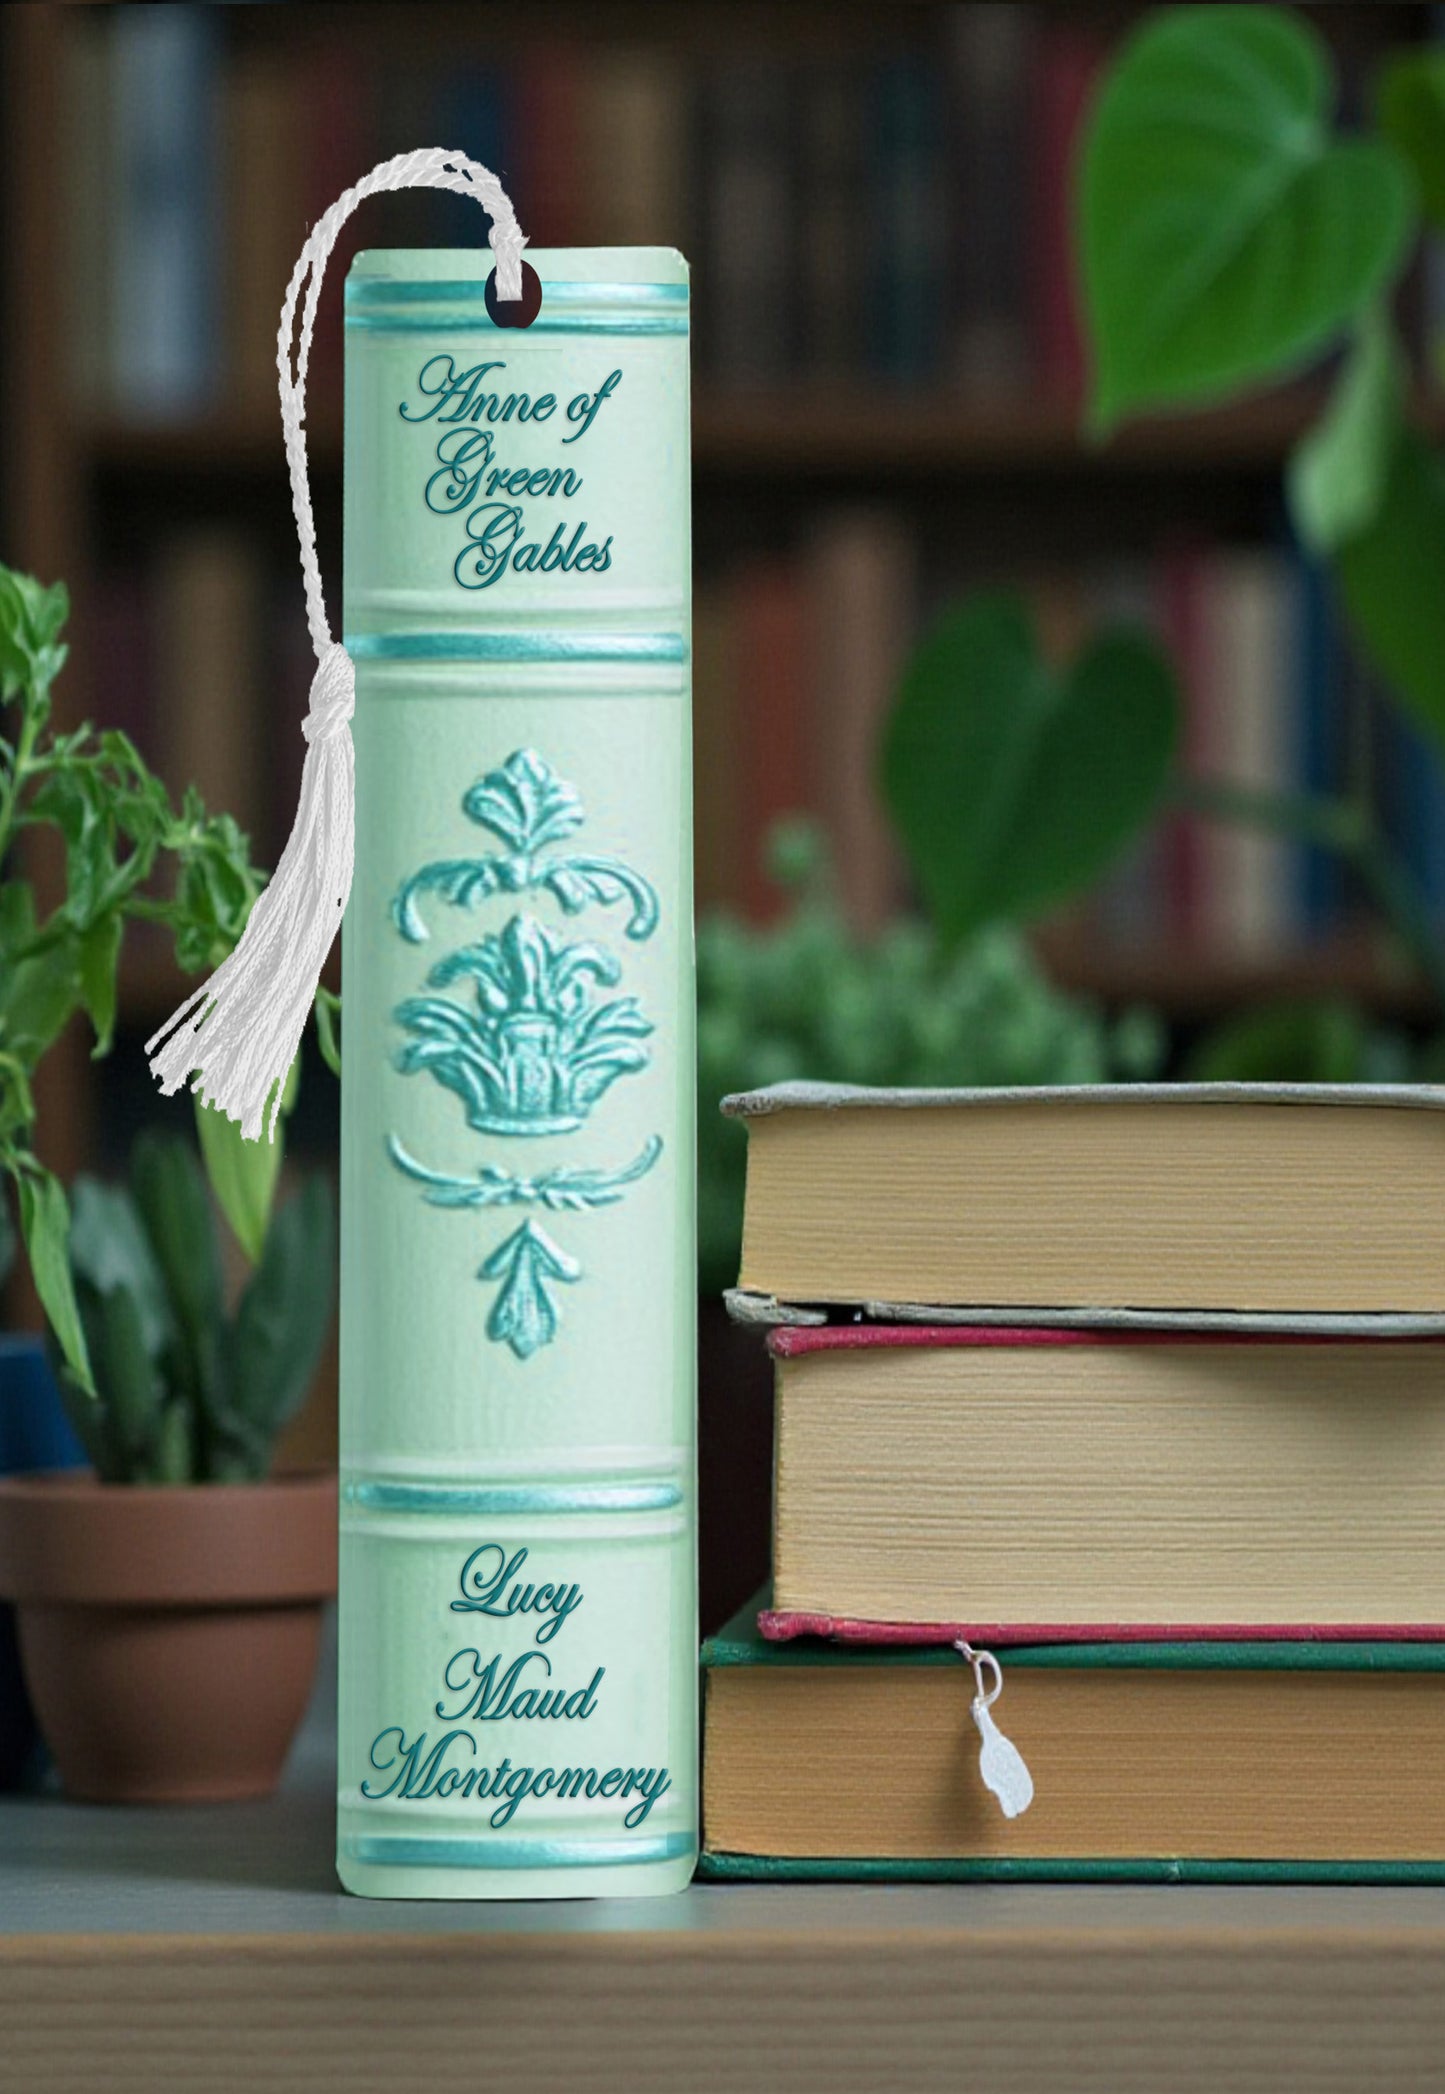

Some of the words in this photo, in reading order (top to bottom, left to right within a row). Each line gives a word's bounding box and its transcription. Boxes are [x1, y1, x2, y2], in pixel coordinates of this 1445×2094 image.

[399, 354, 558, 422] Anne
[562, 368, 623, 444] of
[425, 427, 583, 514] Green
[454, 502, 614, 590] Gables
[450, 1543, 584, 1644] Lucy
[435, 1648, 606, 1721] Maud
[361, 1726, 673, 1829] Montgomery
